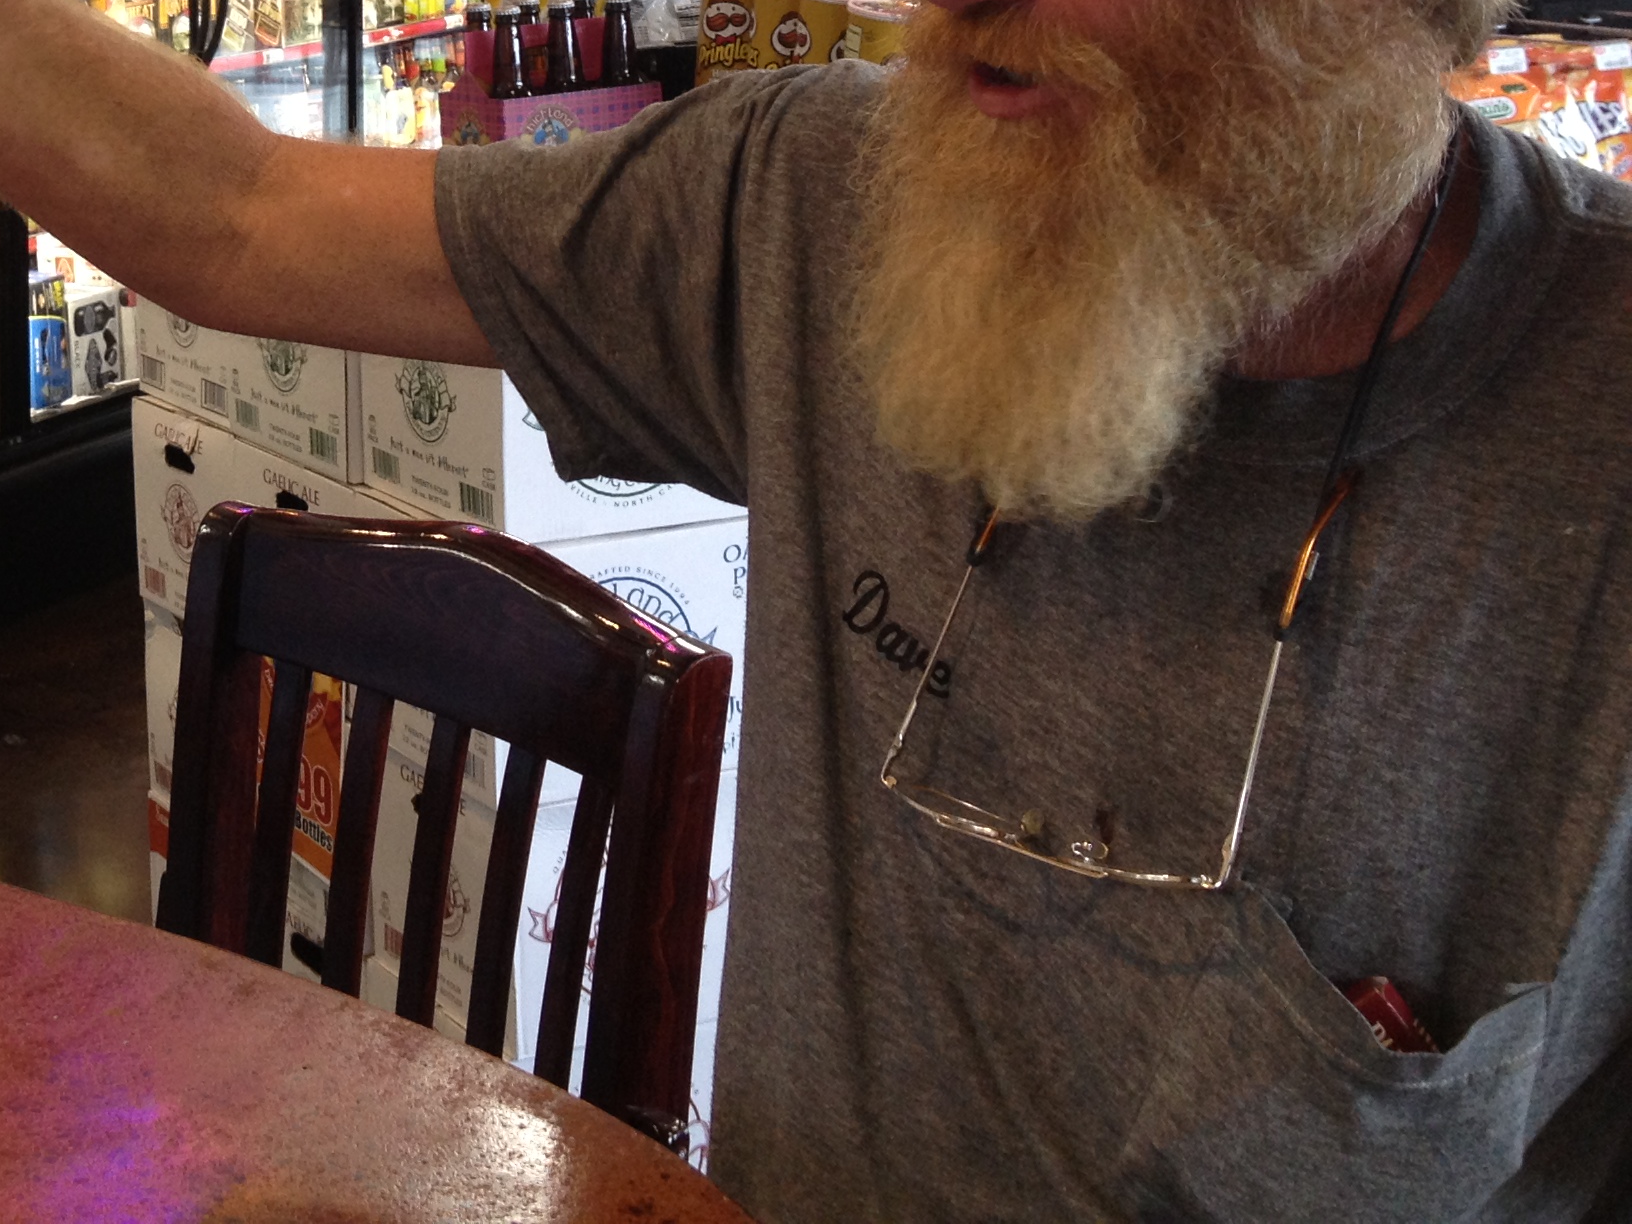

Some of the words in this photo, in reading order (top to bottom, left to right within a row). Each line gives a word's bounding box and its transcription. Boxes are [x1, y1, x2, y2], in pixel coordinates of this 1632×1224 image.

[699, 37, 759, 68] Pringles
[262, 468, 300, 497] GAELIC
[300, 487, 321, 507] ALE
[613, 494, 654, 508] NORTH
[589, 565, 631, 580] RAFTED
[635, 565, 667, 584] SINCE
[842, 569, 953, 699] Dave
[295, 807, 334, 853] Bottles
